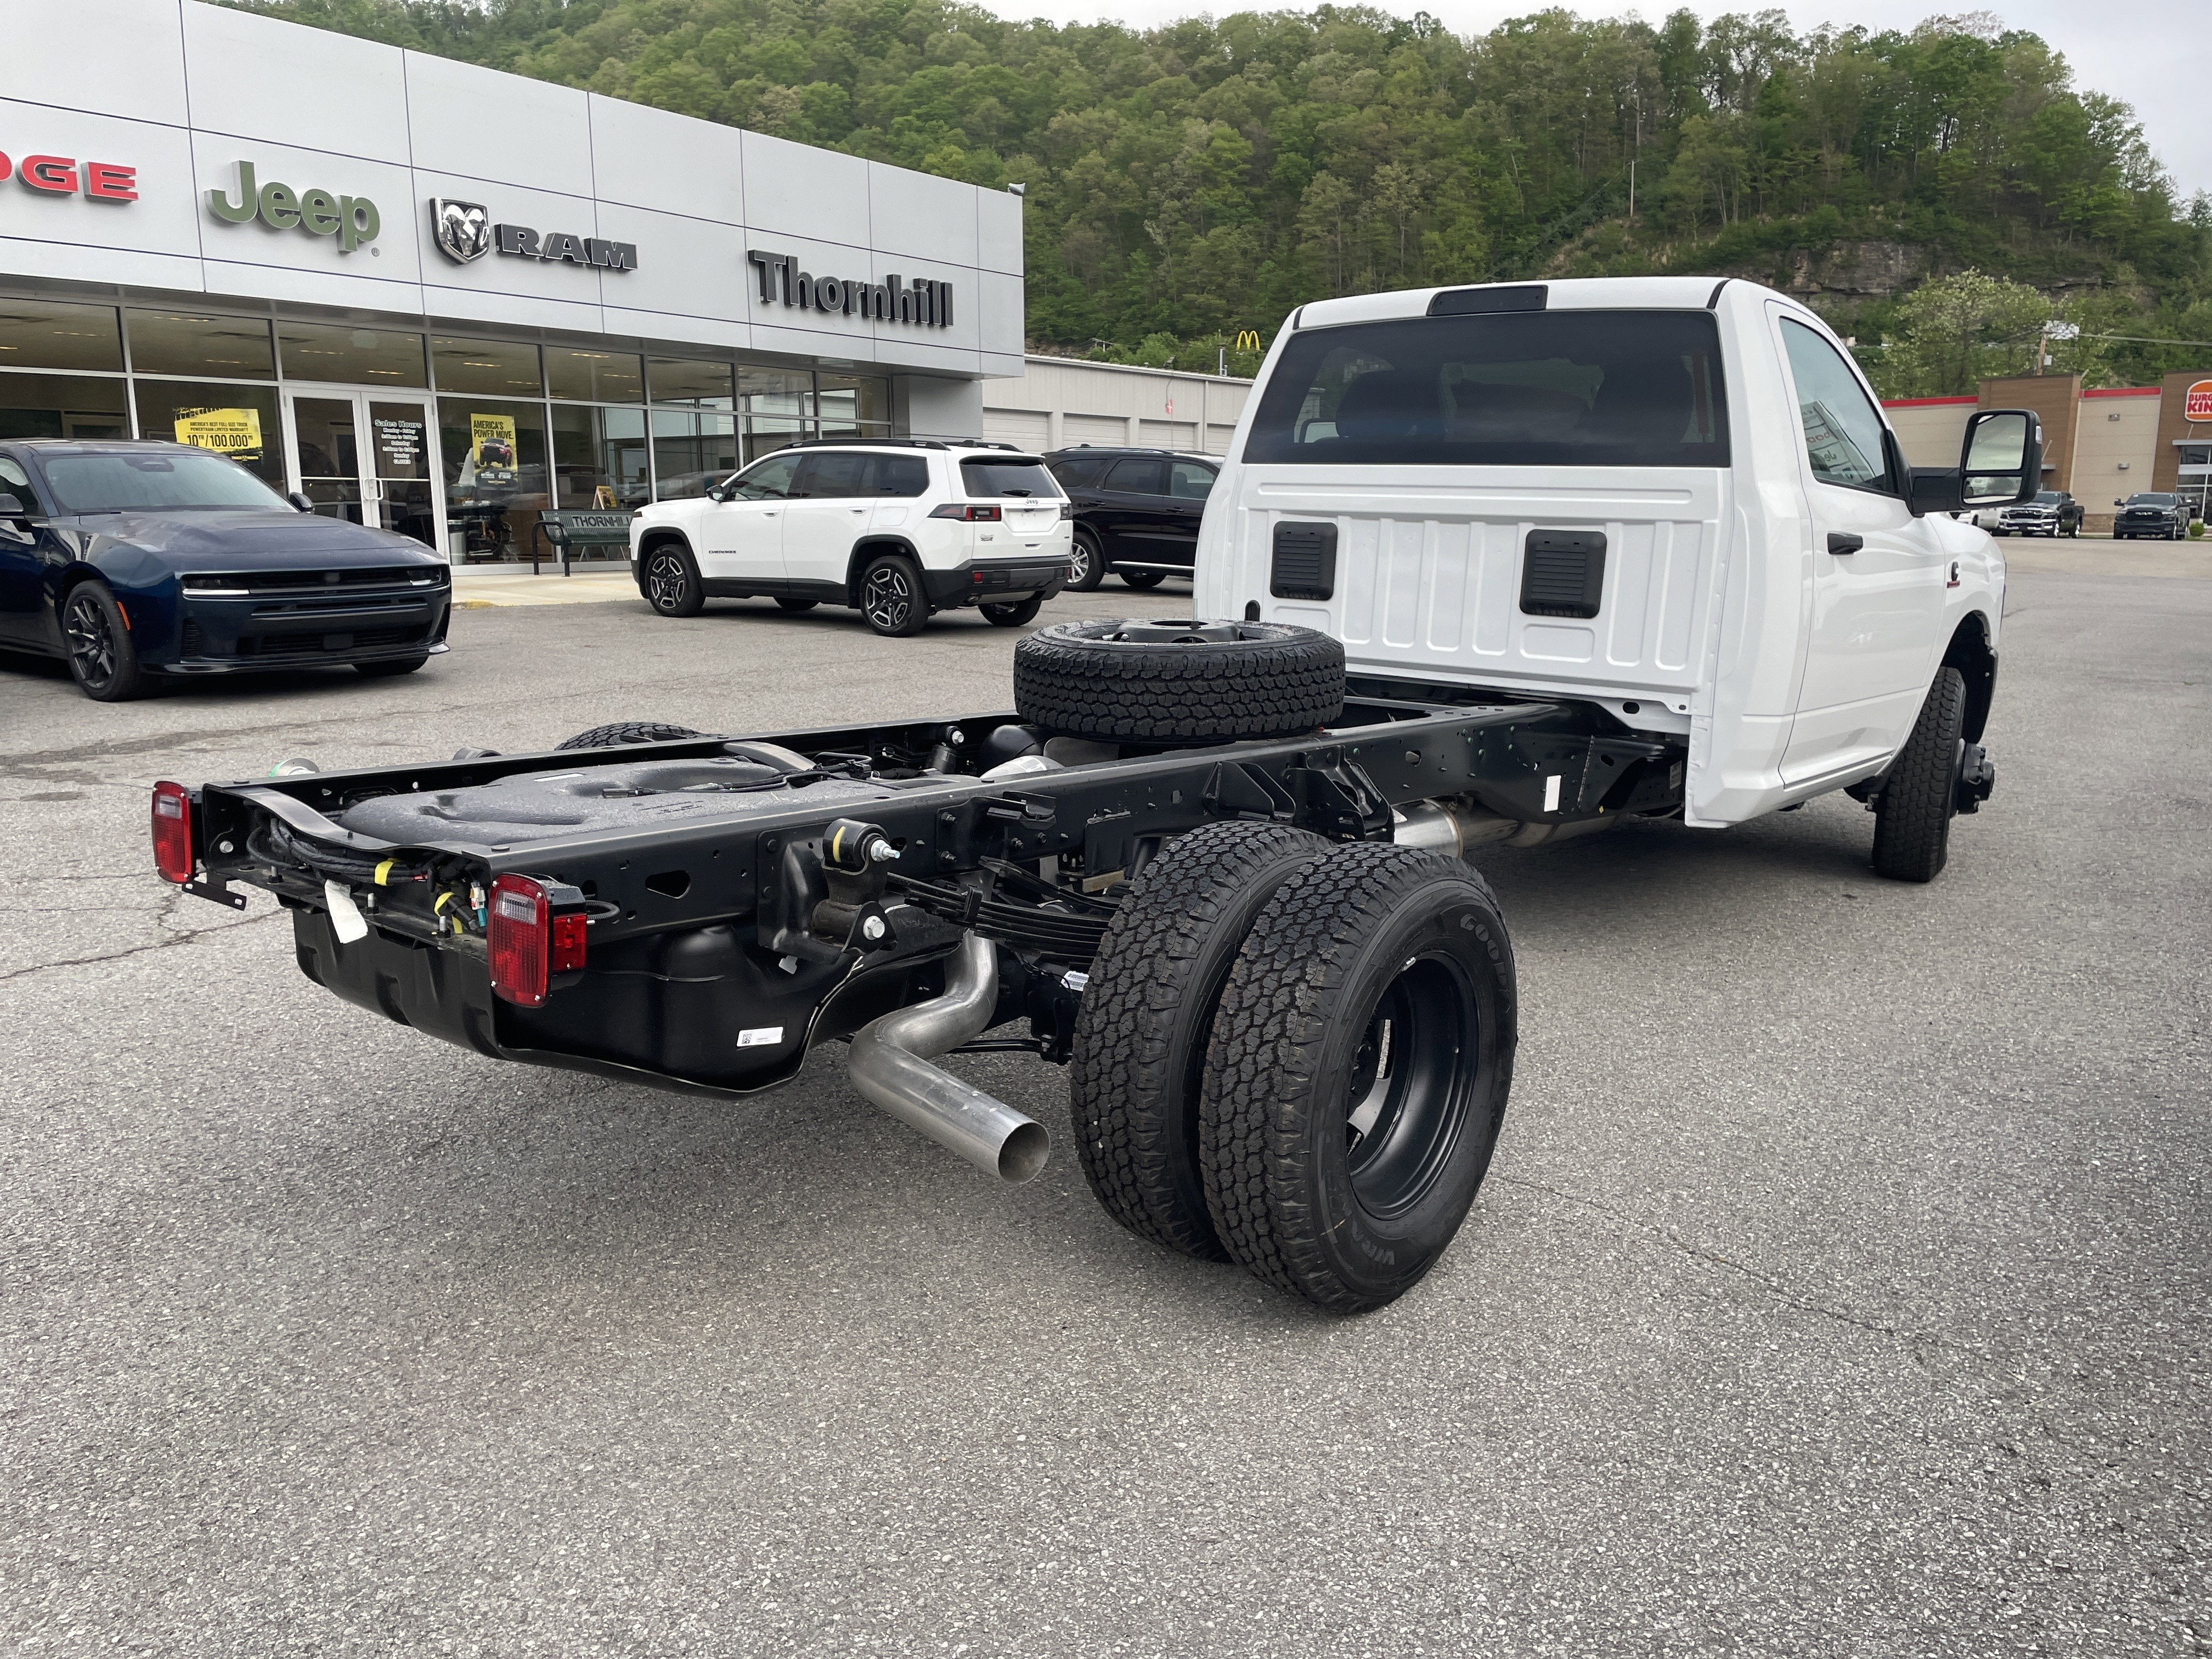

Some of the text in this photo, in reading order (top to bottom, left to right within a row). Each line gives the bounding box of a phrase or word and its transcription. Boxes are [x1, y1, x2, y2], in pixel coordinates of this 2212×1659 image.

[0, 150, 139, 202] GE
[205, 160, 380, 252] Jeep
[494, 223, 637, 270] RAM
[748, 250, 953, 327] Thornhill
[398, 420, 422, 428] Hours
[473, 420, 504, 430] AMERICA'S
[473, 429, 494, 438] POWER
[187, 435, 198, 446] 10
